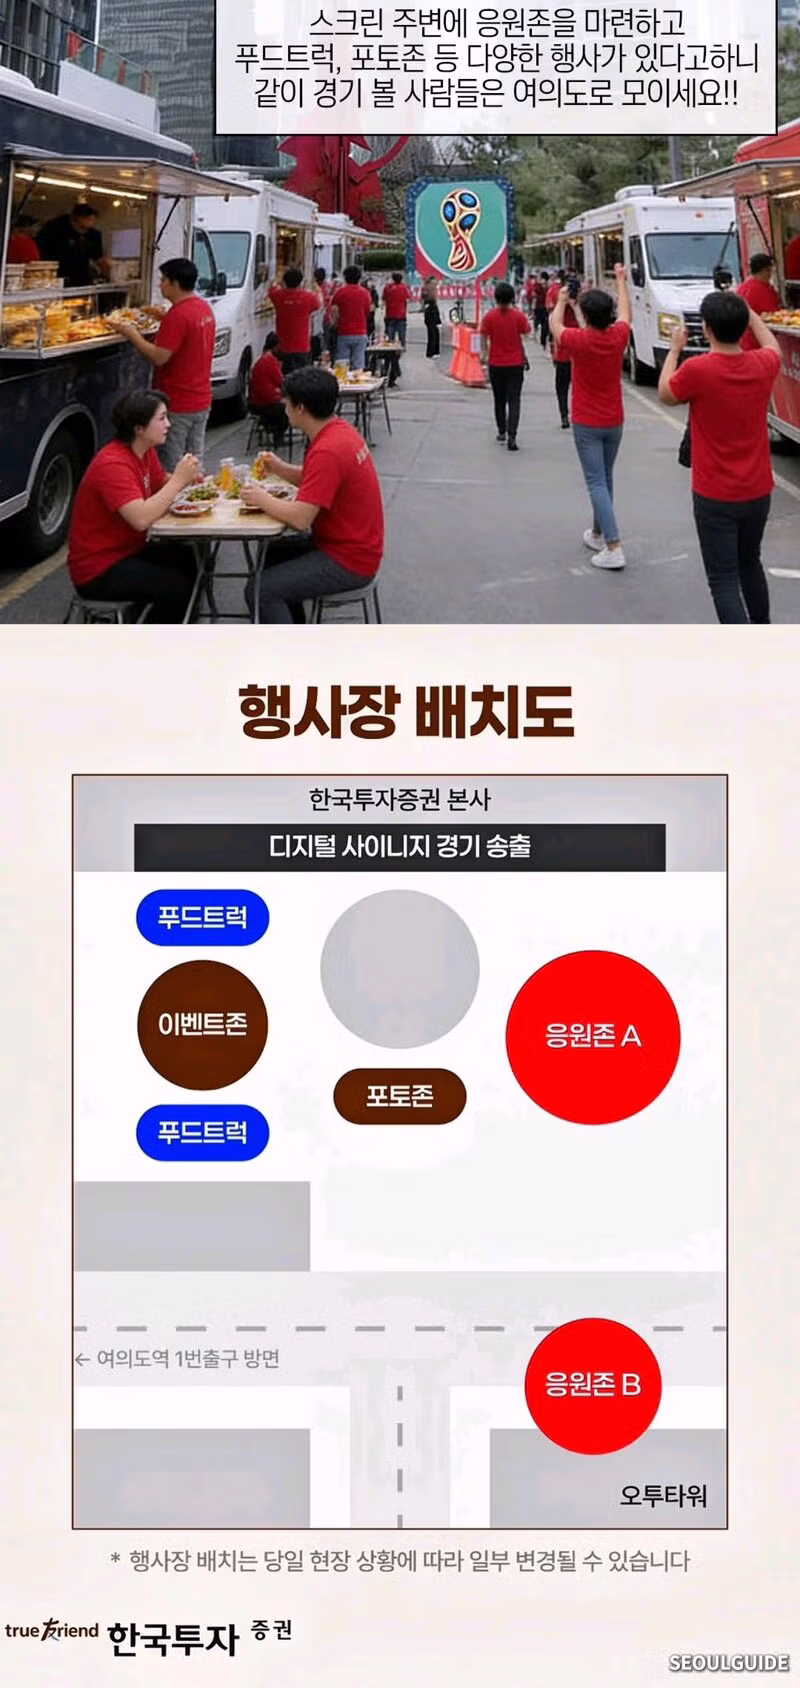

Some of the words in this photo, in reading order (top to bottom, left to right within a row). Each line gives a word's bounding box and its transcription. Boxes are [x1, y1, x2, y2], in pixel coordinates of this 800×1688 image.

[238, 683, 402, 740] 행사장
[416, 684, 575, 739] 배치도
[309, 787, 441, 812] 한국투자증권
[446, 787, 492, 812] 본사
[269, 834, 336, 859] 디지털
[341, 834, 431, 859] 사이니지
[436, 834, 480, 859] 경기
[486, 833, 531, 860] 송출
[158, 906, 247, 930] 푸드트럭
[158, 1012, 248, 1036] 이벤트존
[545, 1023, 616, 1048] 응원존
[620, 1024, 642, 1047] A
[366, 1084, 434, 1109] 포토존
[158, 1121, 247, 1145] 푸드트럭
[97, 1348, 169, 1369] 여의도역
[175, 1348, 239, 1369] 1번출구
[243, 1348, 279, 1369] 방면
[545, 1371, 616, 1397] 응원존
[622, 1373, 641, 1396] B
[619, 1484, 708, 1509] 오투타워
[129, 1549, 192, 1573] 행사장
[197, 1549, 259, 1573] 배치는
[263, 1549, 304, 1573] 당일
[309, 1549, 352, 1573] 현장
[356, 1549, 417, 1573] 상황에
[423, 1549, 465, 1573] 따라
[469, 1549, 511, 1573] 일부
[516, 1549, 577, 1573] 변경될
[582, 1549, 603, 1573] 수
[608, 1549, 691, 1573] 있습니다
[106, 1622, 241, 1658] 한국투자
[250, 1619, 292, 1641] 증권
